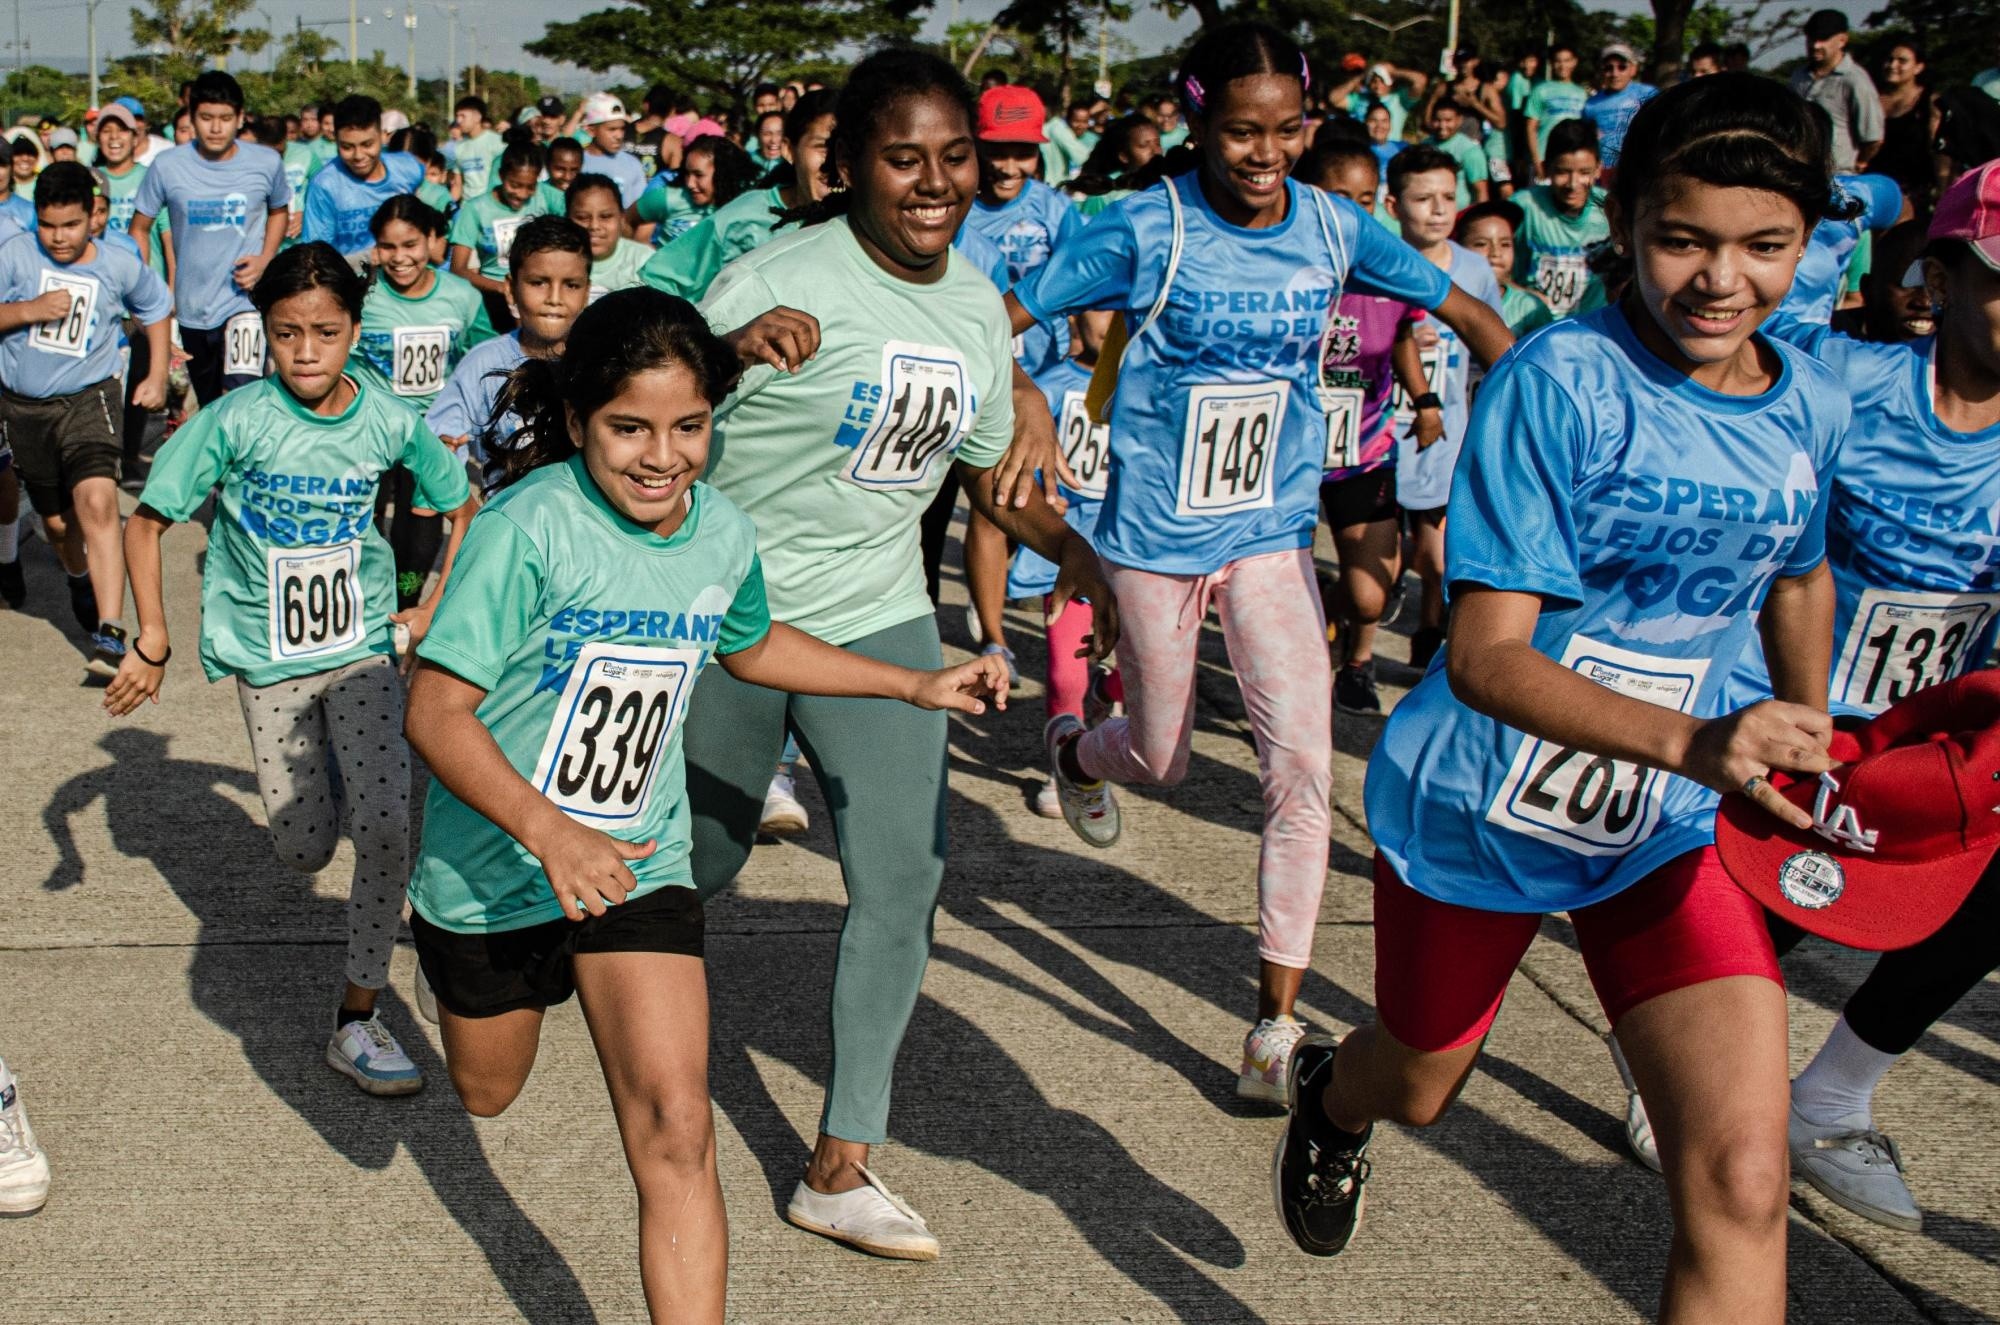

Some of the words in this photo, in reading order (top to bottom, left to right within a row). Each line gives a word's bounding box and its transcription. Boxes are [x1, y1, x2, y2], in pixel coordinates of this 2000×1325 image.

[231, 328, 260, 367] 304
[403, 344, 439, 386] 233
[1270, 317, 1320, 338] DEL
[871, 382, 957, 471] 146
[1202, 413, 1268, 498] 148
[1578, 514, 1724, 557] LEJOS
[284, 568, 350, 646] 690
[557, 685, 669, 806] 339
[1813, 771, 1879, 853] LA
